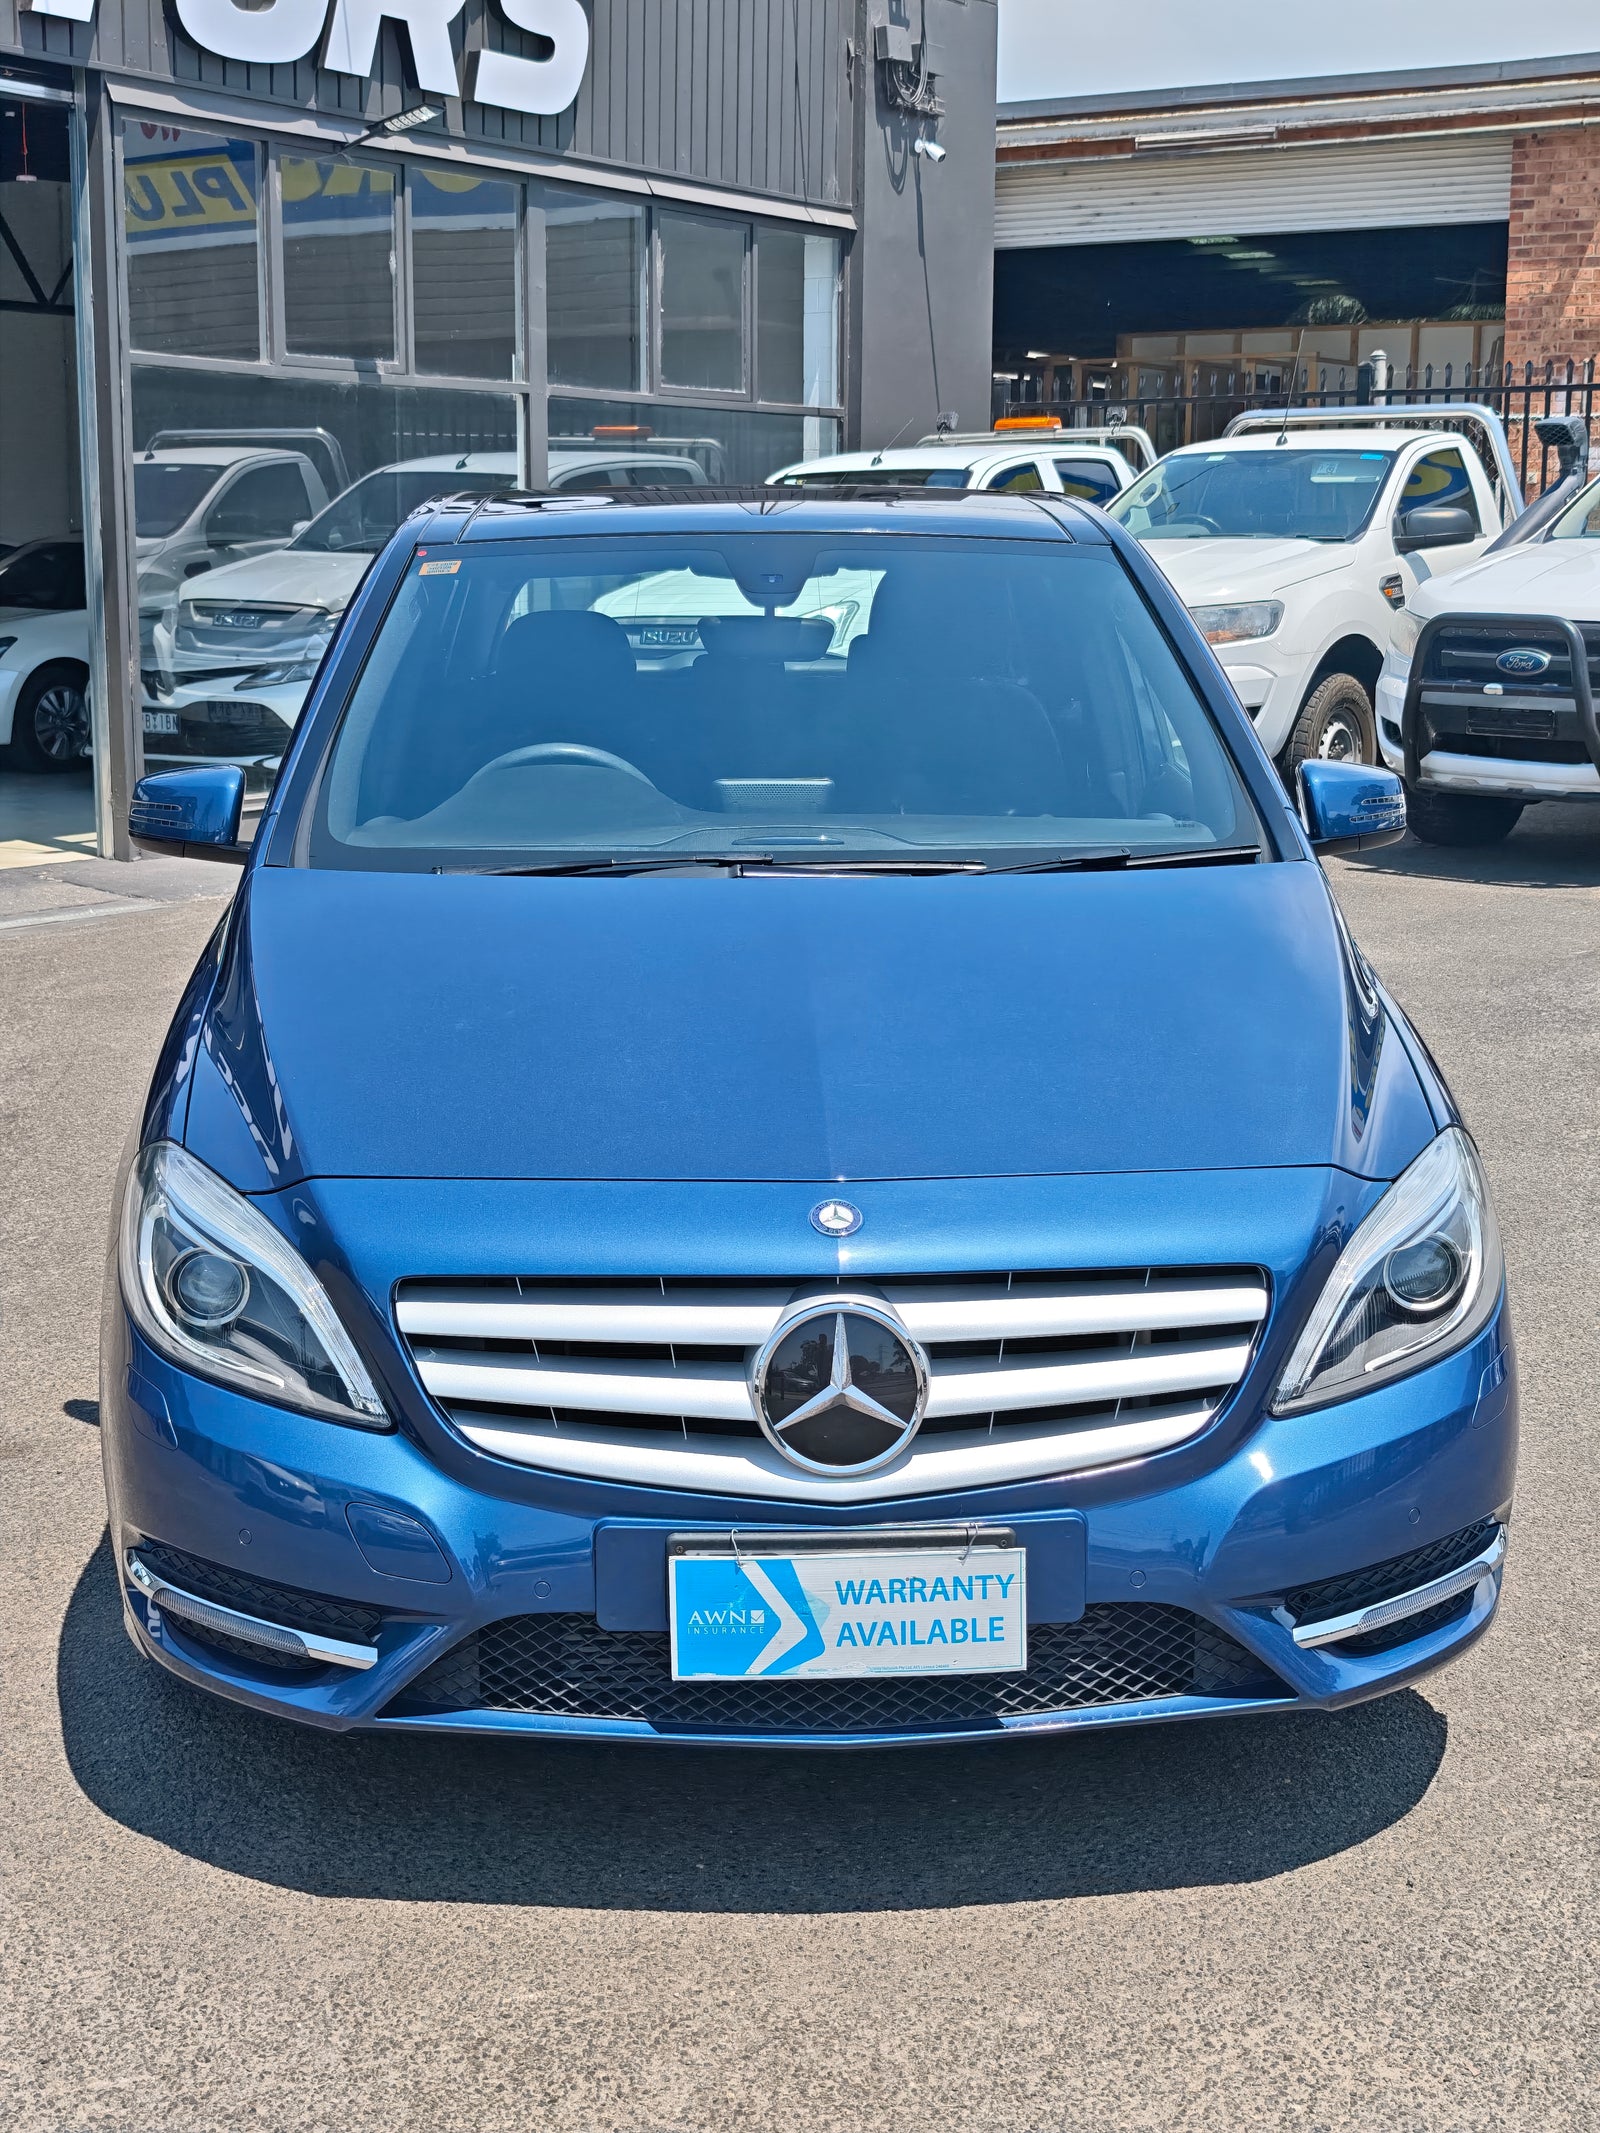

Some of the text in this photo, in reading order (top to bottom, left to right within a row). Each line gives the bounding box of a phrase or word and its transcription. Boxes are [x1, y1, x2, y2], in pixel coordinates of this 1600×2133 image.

[642, 630, 694, 643] ISUZU
[1506, 655, 1535, 670] Ford
[834, 1573, 1015, 1605] WARRANTY
[688, 1610, 746, 1624] AWN
[687, 1626, 765, 1635] INSURANCE
[836, 1616, 1005, 1647] AVAILABLE
